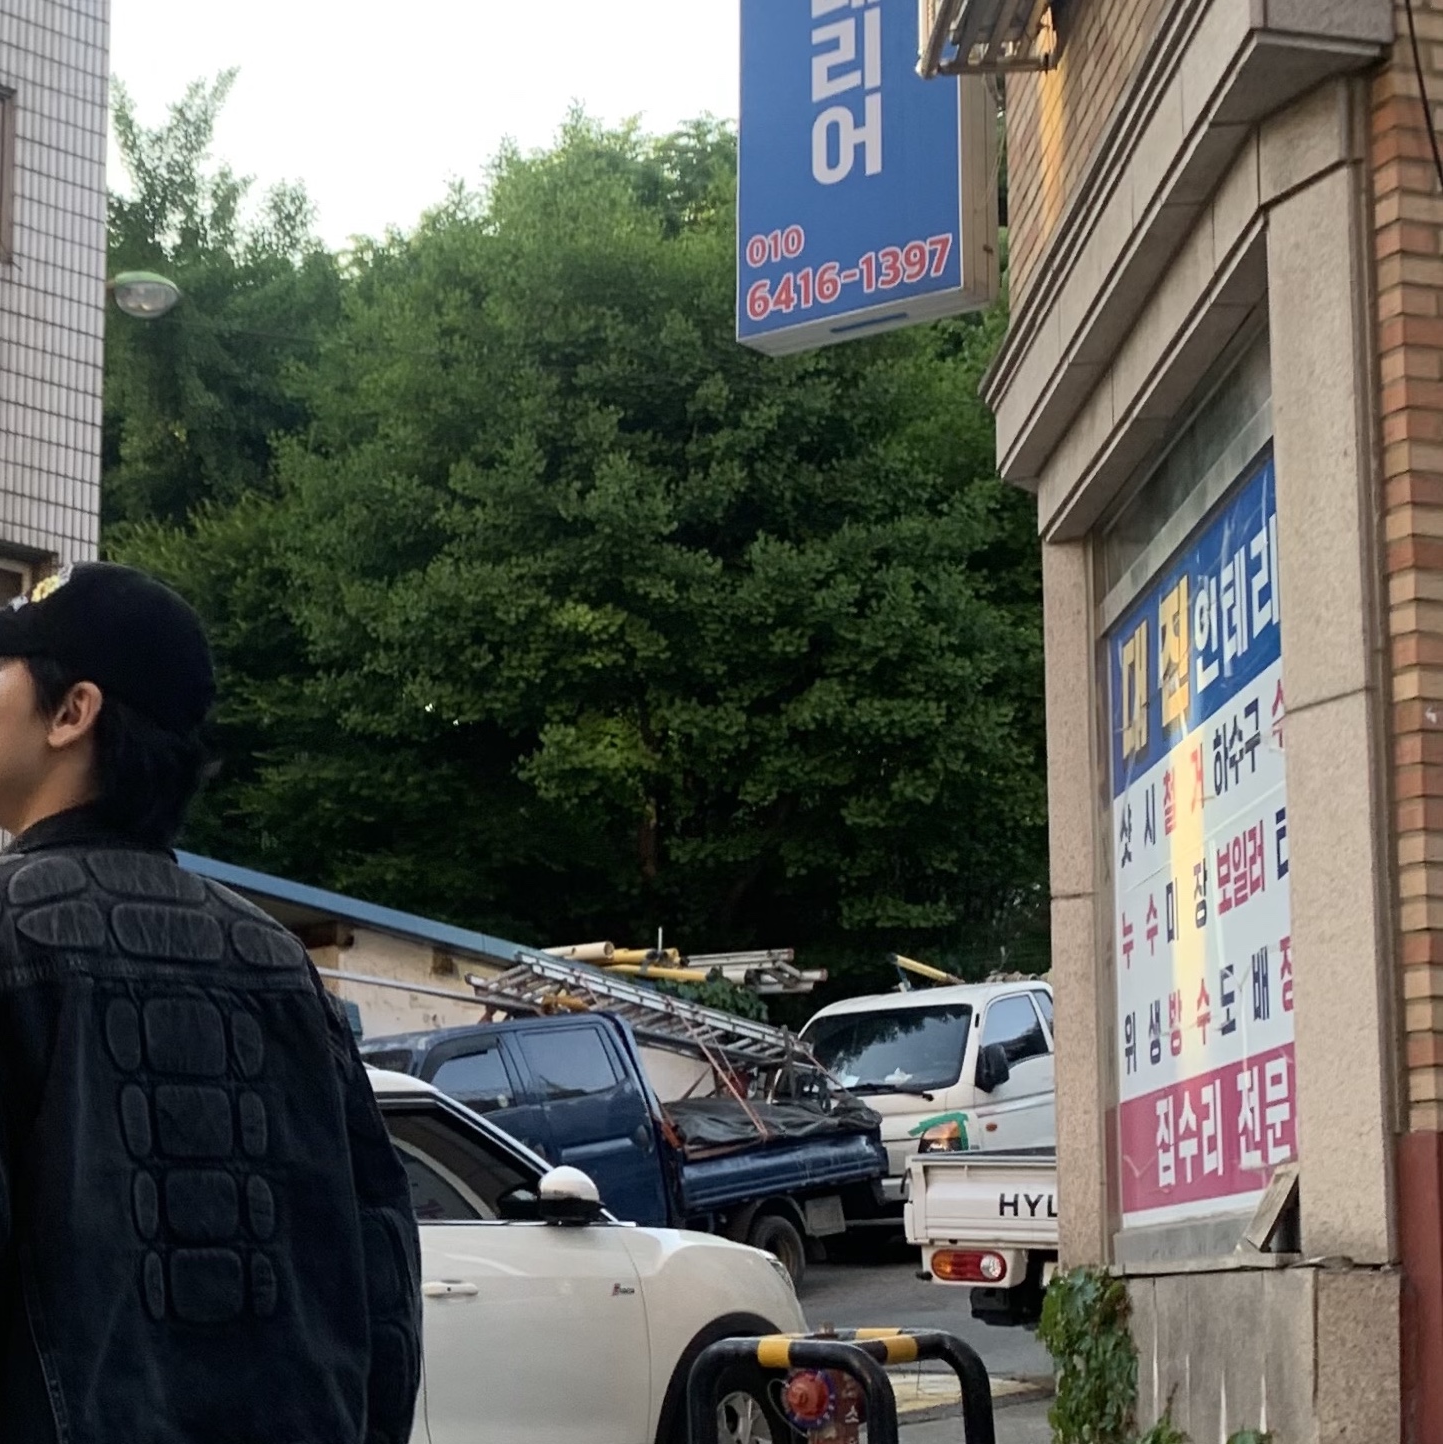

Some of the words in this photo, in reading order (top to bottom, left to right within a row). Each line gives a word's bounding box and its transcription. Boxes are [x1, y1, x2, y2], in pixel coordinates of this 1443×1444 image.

[811, 0, 883, 185] 리어
[746, 224, 805, 268] 010
[746, 232, 953, 321] 6416-1397
[1213, 697, 1261, 795] 하수구
[1217, 819, 1265, 915] 보일러
[1156, 1079, 1224, 1188] 집수리
[1237, 1057, 1291, 1171] 전문
